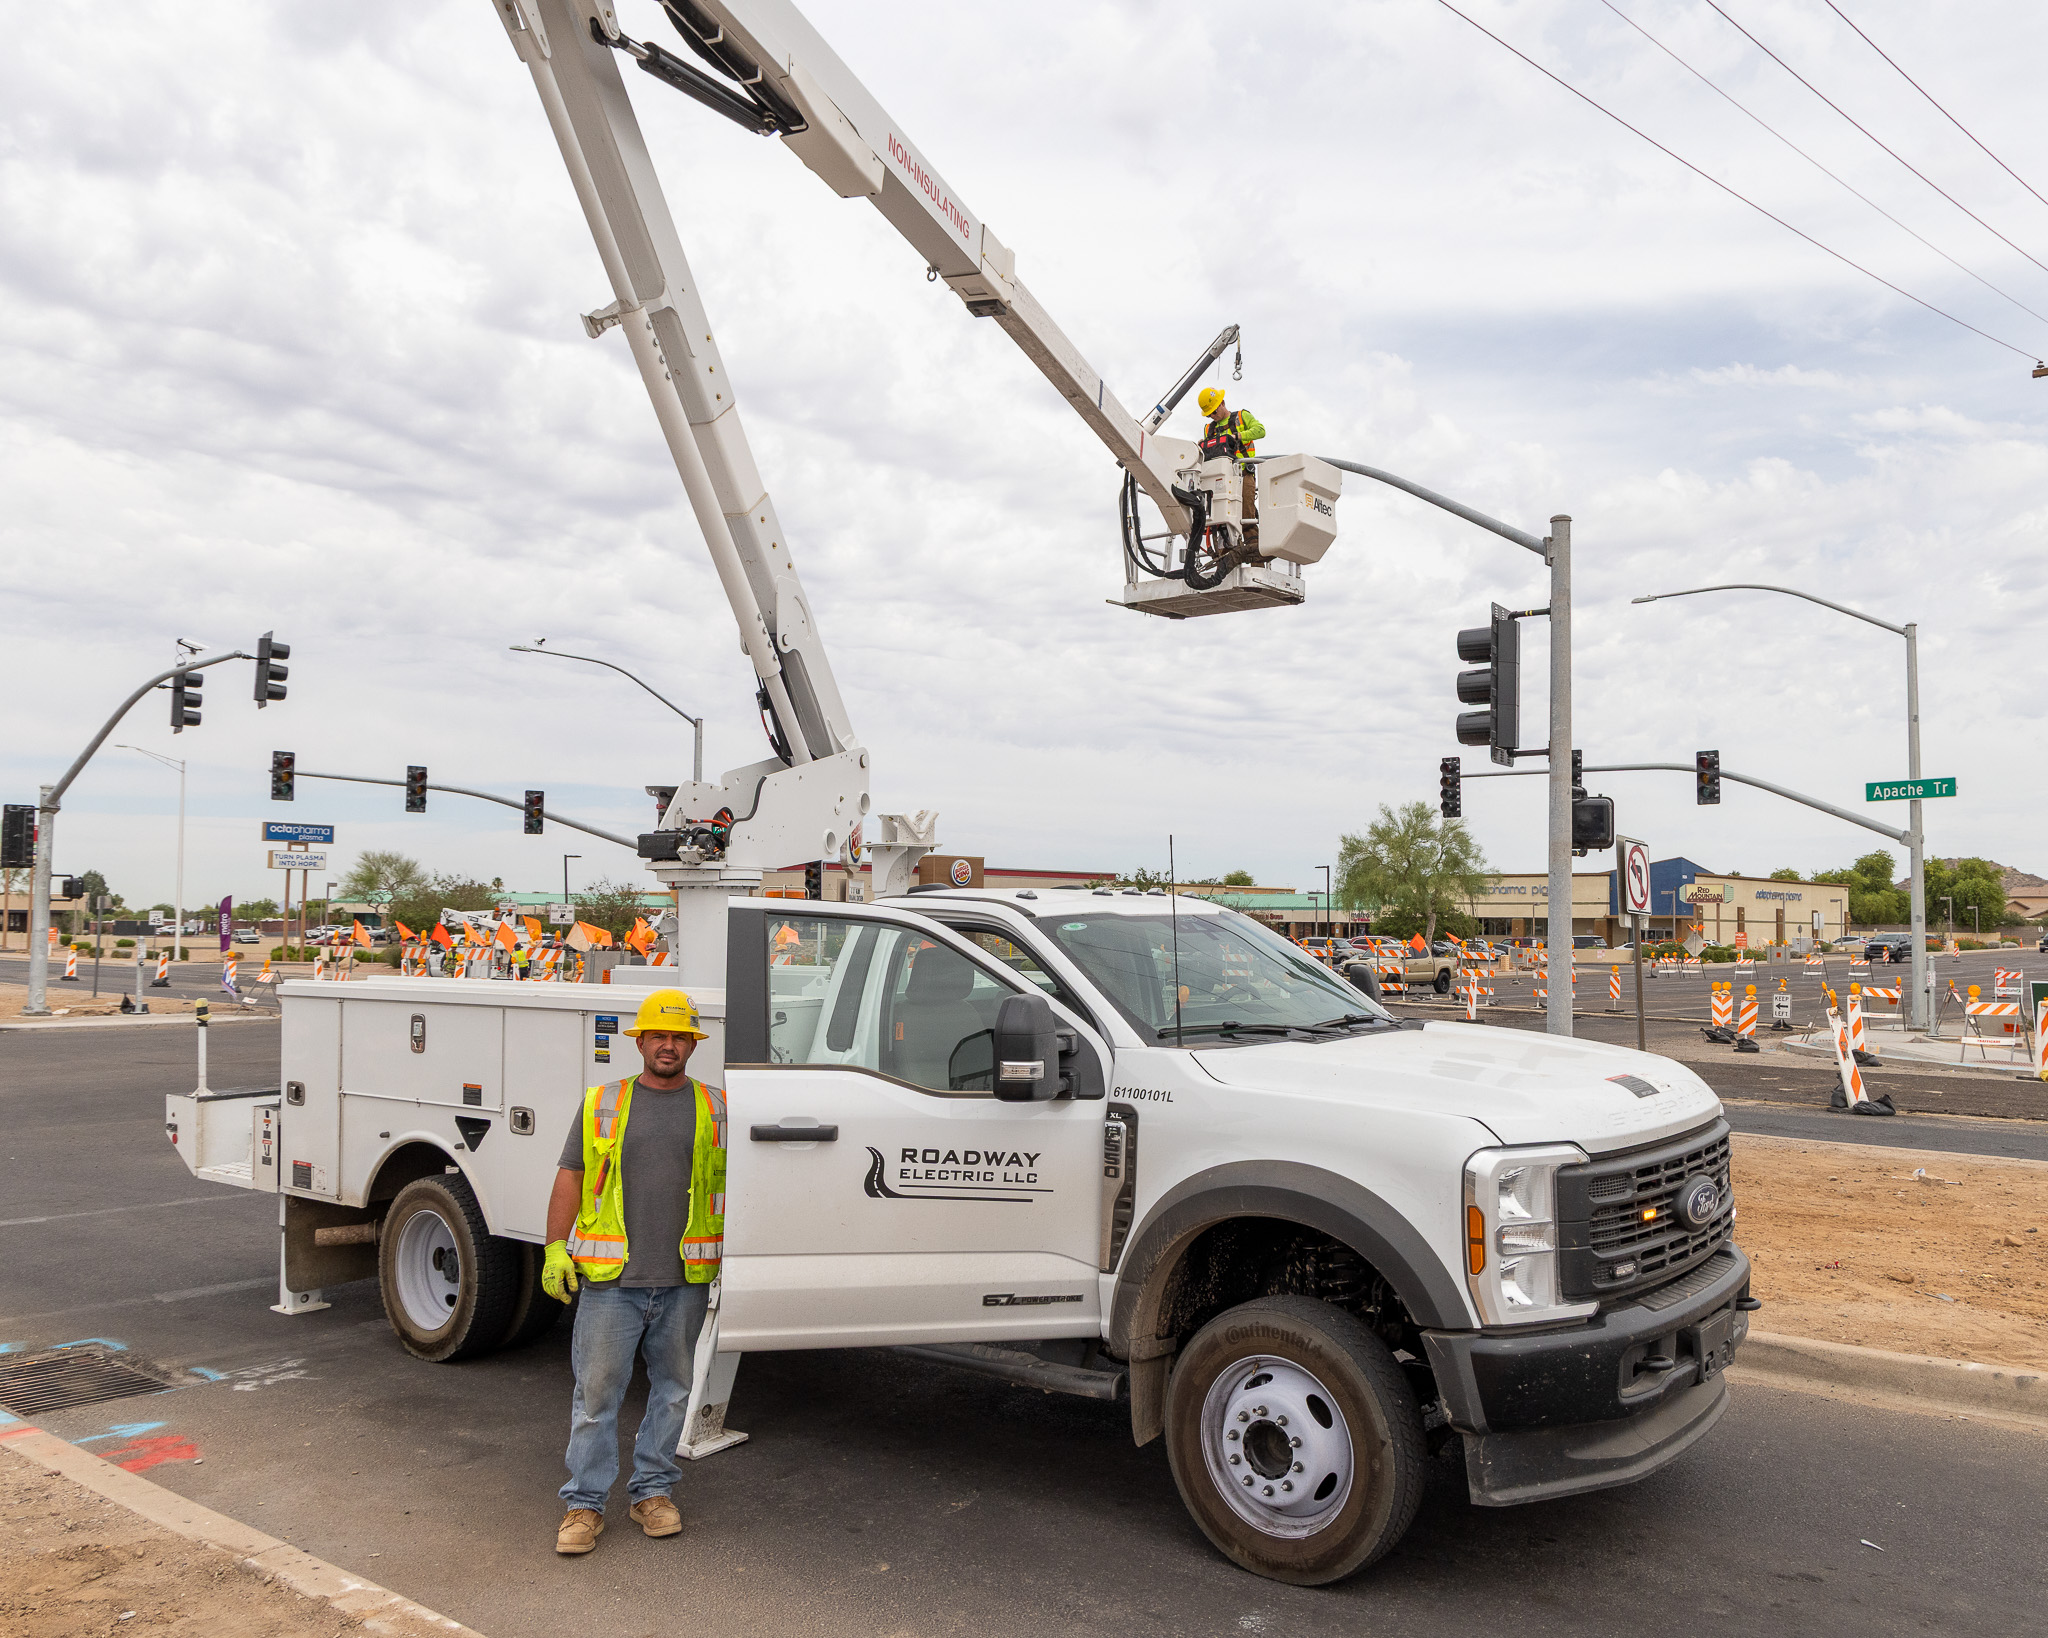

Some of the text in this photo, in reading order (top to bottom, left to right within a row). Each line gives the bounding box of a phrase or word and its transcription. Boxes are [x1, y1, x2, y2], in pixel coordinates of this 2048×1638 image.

[888, 132, 970, 240] NON-INSULATING
[1313, 497, 1332, 517] Altec
[1873, 781, 1949, 800] Apache Tr
[269, 824, 330, 835] octapharma
[221, 913, 229, 935] metro
[1113, 1086, 1174, 1103] 61100101L
[901, 1147, 1042, 1168] ROADWAY
[899, 1168, 1038, 1184] ELECTRIC LLC
[1697, 1190, 1715, 1217] Ford
[1224, 1321, 1313, 1352] Continental
